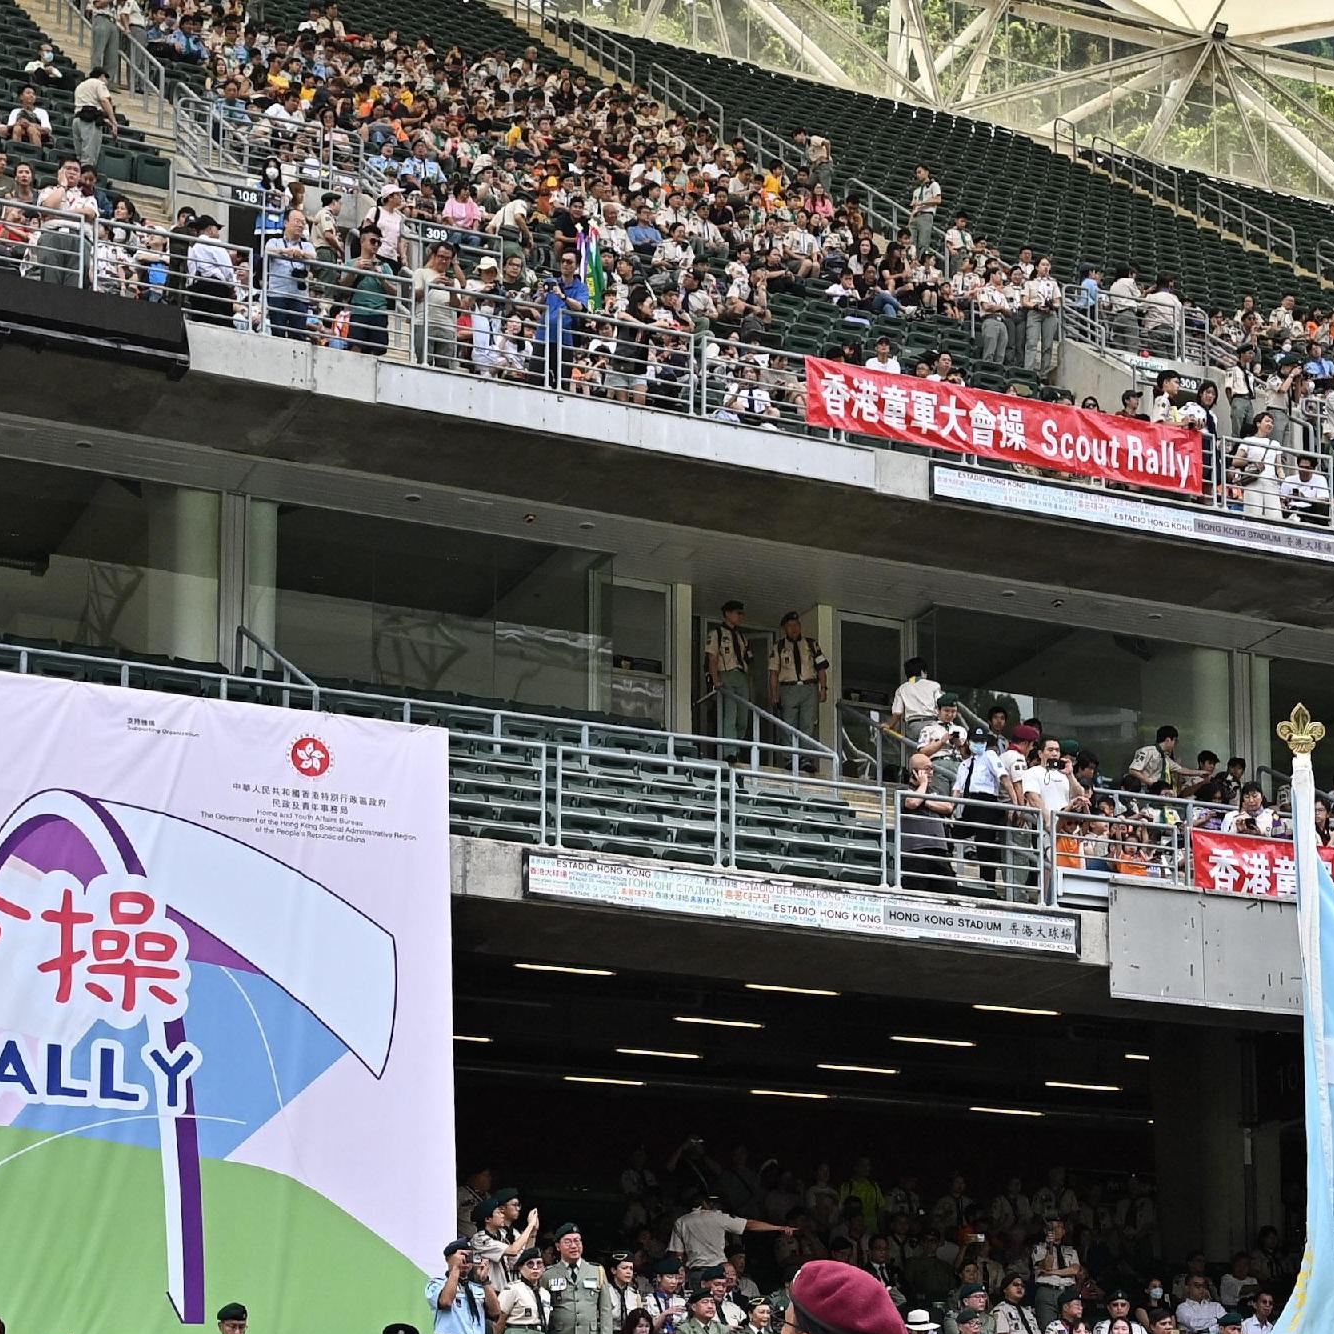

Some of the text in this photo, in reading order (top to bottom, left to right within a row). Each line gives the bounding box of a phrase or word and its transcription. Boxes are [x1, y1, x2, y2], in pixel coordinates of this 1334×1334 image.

[426, 227, 448, 240] 309
[1180, 377, 1197, 390] 309
[820, 372, 1191, 489] 香港童軍大會操 Scout Rally
[1197, 521, 1222, 533] HONG
[1223, 525, 1246, 538] KONG
[1247, 530, 1281, 543] STADIUM
[215, 812, 258, 824] Government
[280, 821, 299, 829] Hong
[300, 822, 318, 831] Kong
[345, 826, 393, 839] Administrative
[557, 859, 594, 872] ESTADIO
[597, 865, 623, 875] HONG
[627, 868, 652, 879] KONG
[773, 903, 816, 916] ESTADIO
[852, 912, 881, 924] KONG
[889, 909, 1073, 941] HONG KONG STADIUM 香港大球場
